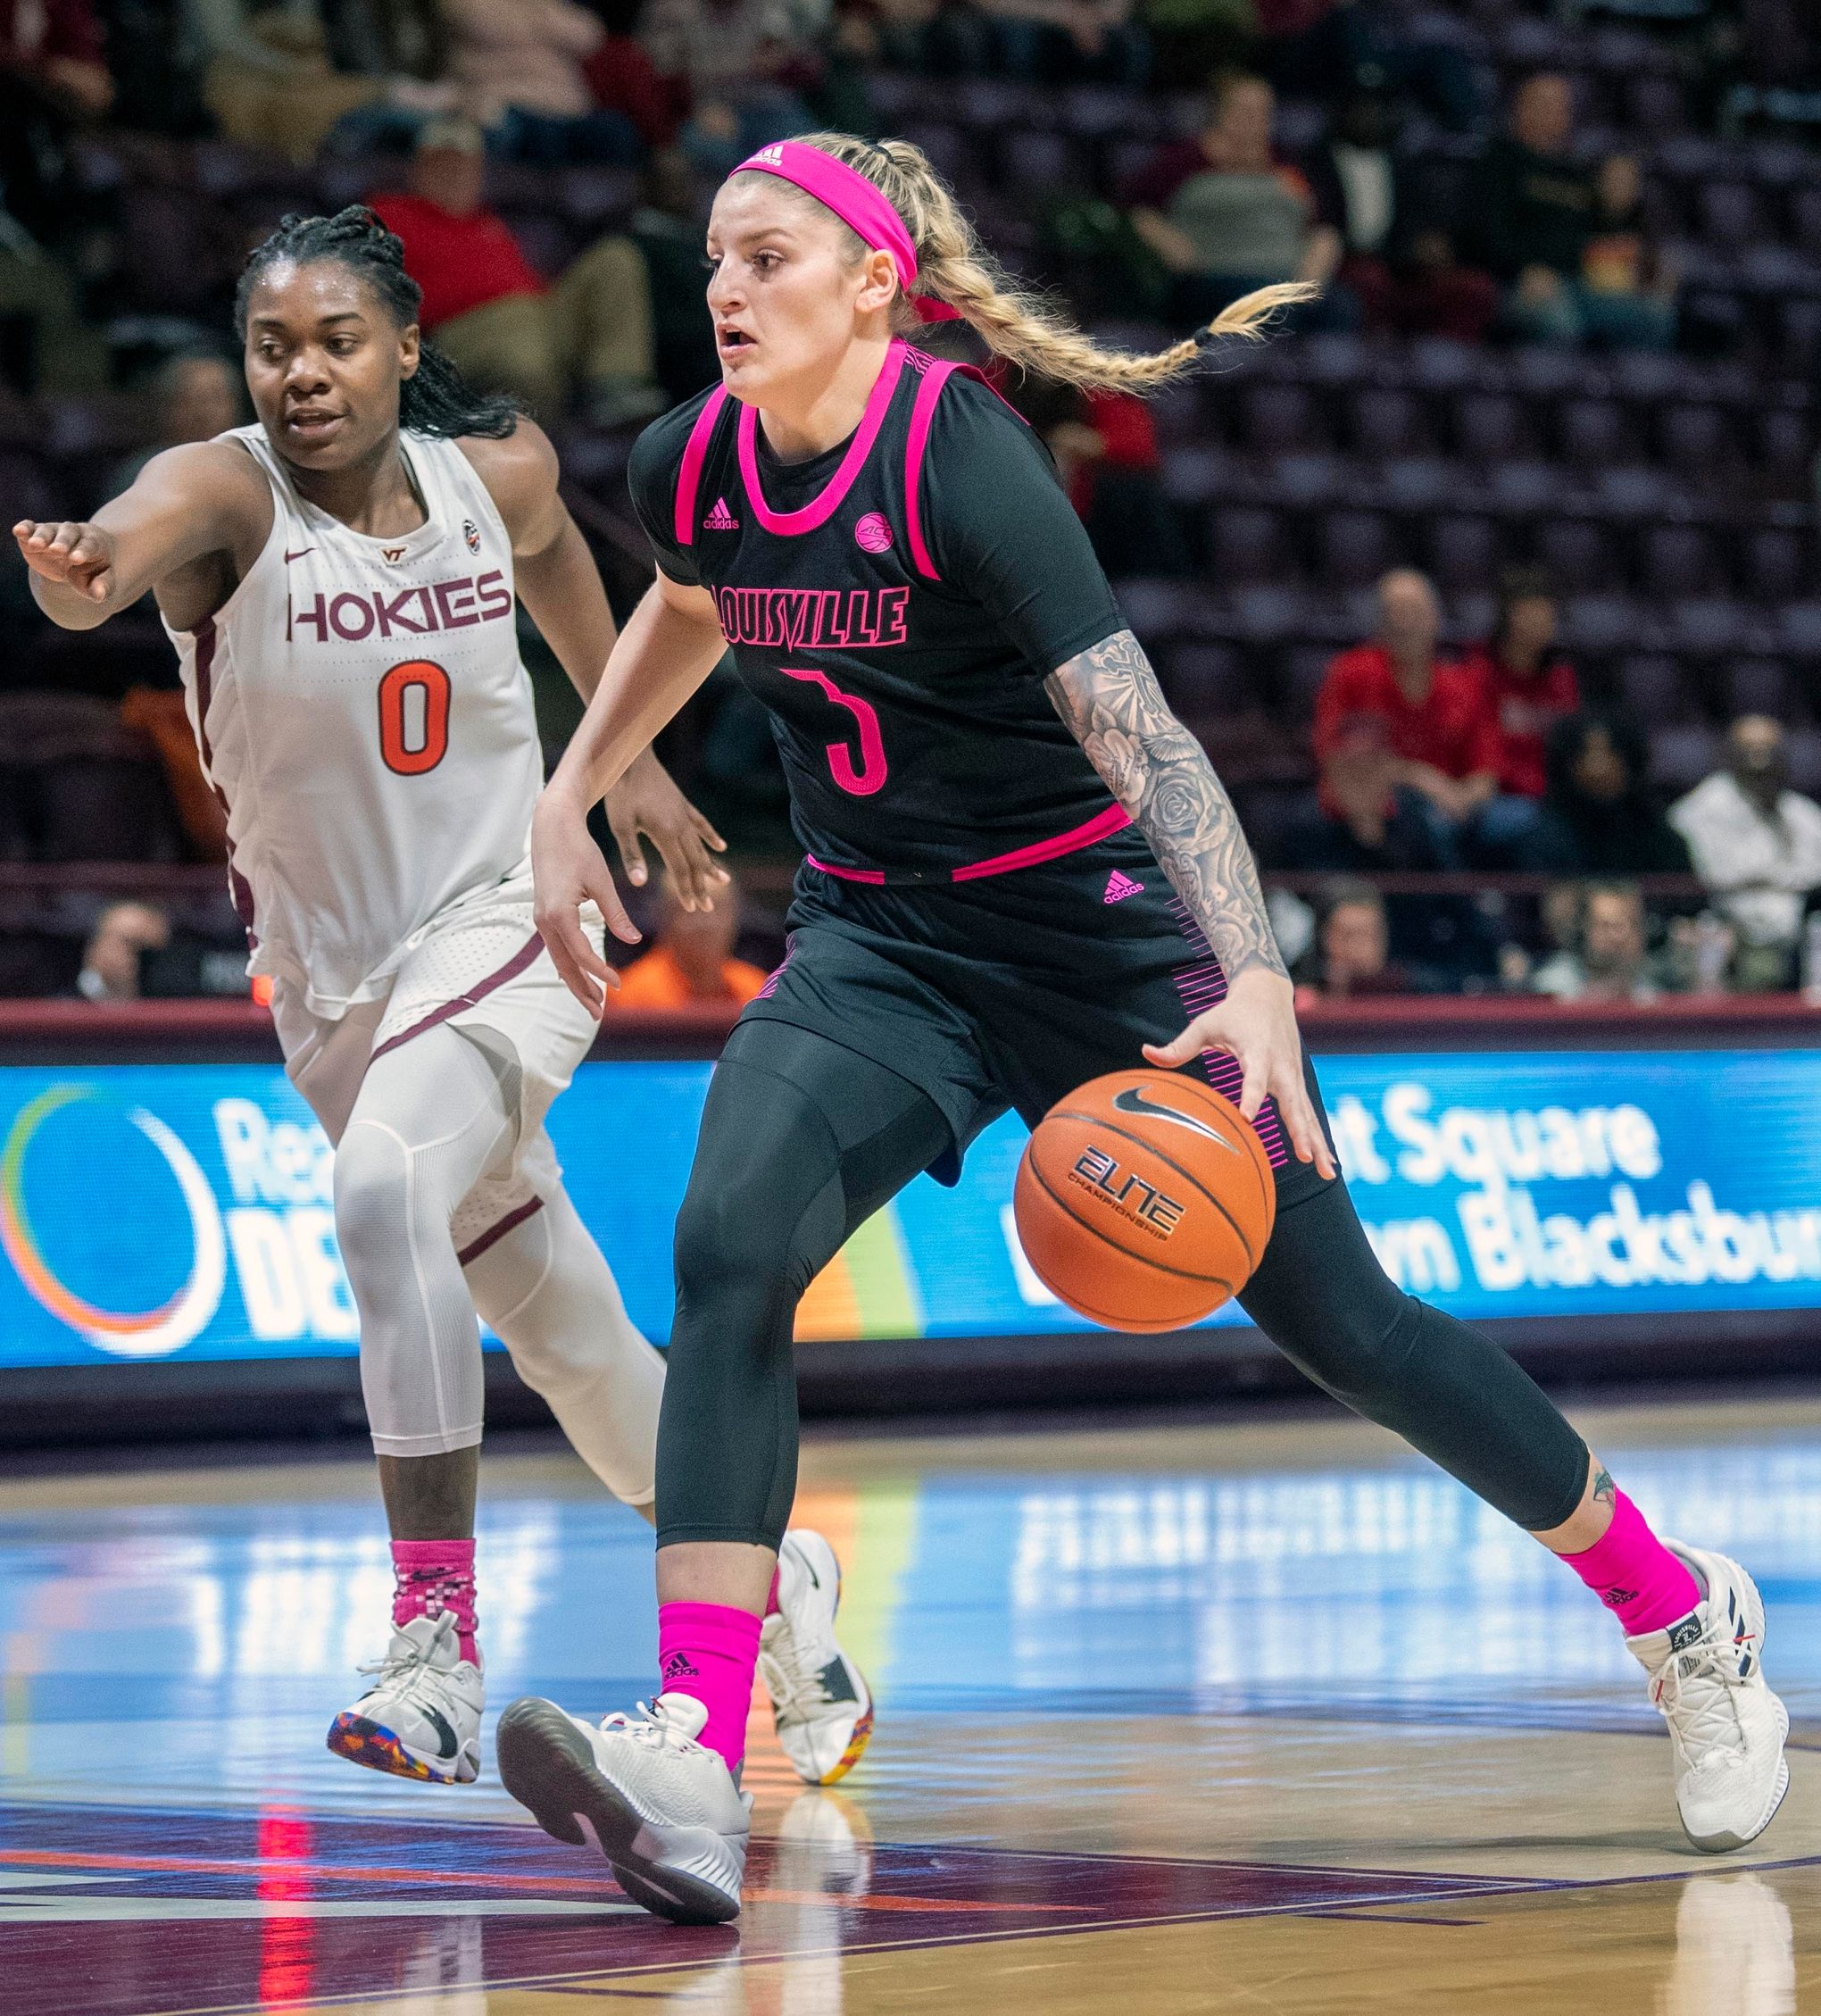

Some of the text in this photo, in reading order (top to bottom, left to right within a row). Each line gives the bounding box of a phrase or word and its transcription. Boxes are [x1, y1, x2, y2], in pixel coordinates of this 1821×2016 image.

[382, 547, 407, 562] VT
[703, 517, 740, 530] adidas
[285, 569, 511, 642] HOKIES
[378, 658, 451, 776] 0
[778, 668, 887, 796] 3
[1103, 882, 1144, 904] adidas
[1383, 1082, 1662, 1198] Square
[1068, 1172, 1168, 1242] CHAMPIONSHIP
[1073, 1144, 1185, 1235] ELITE
